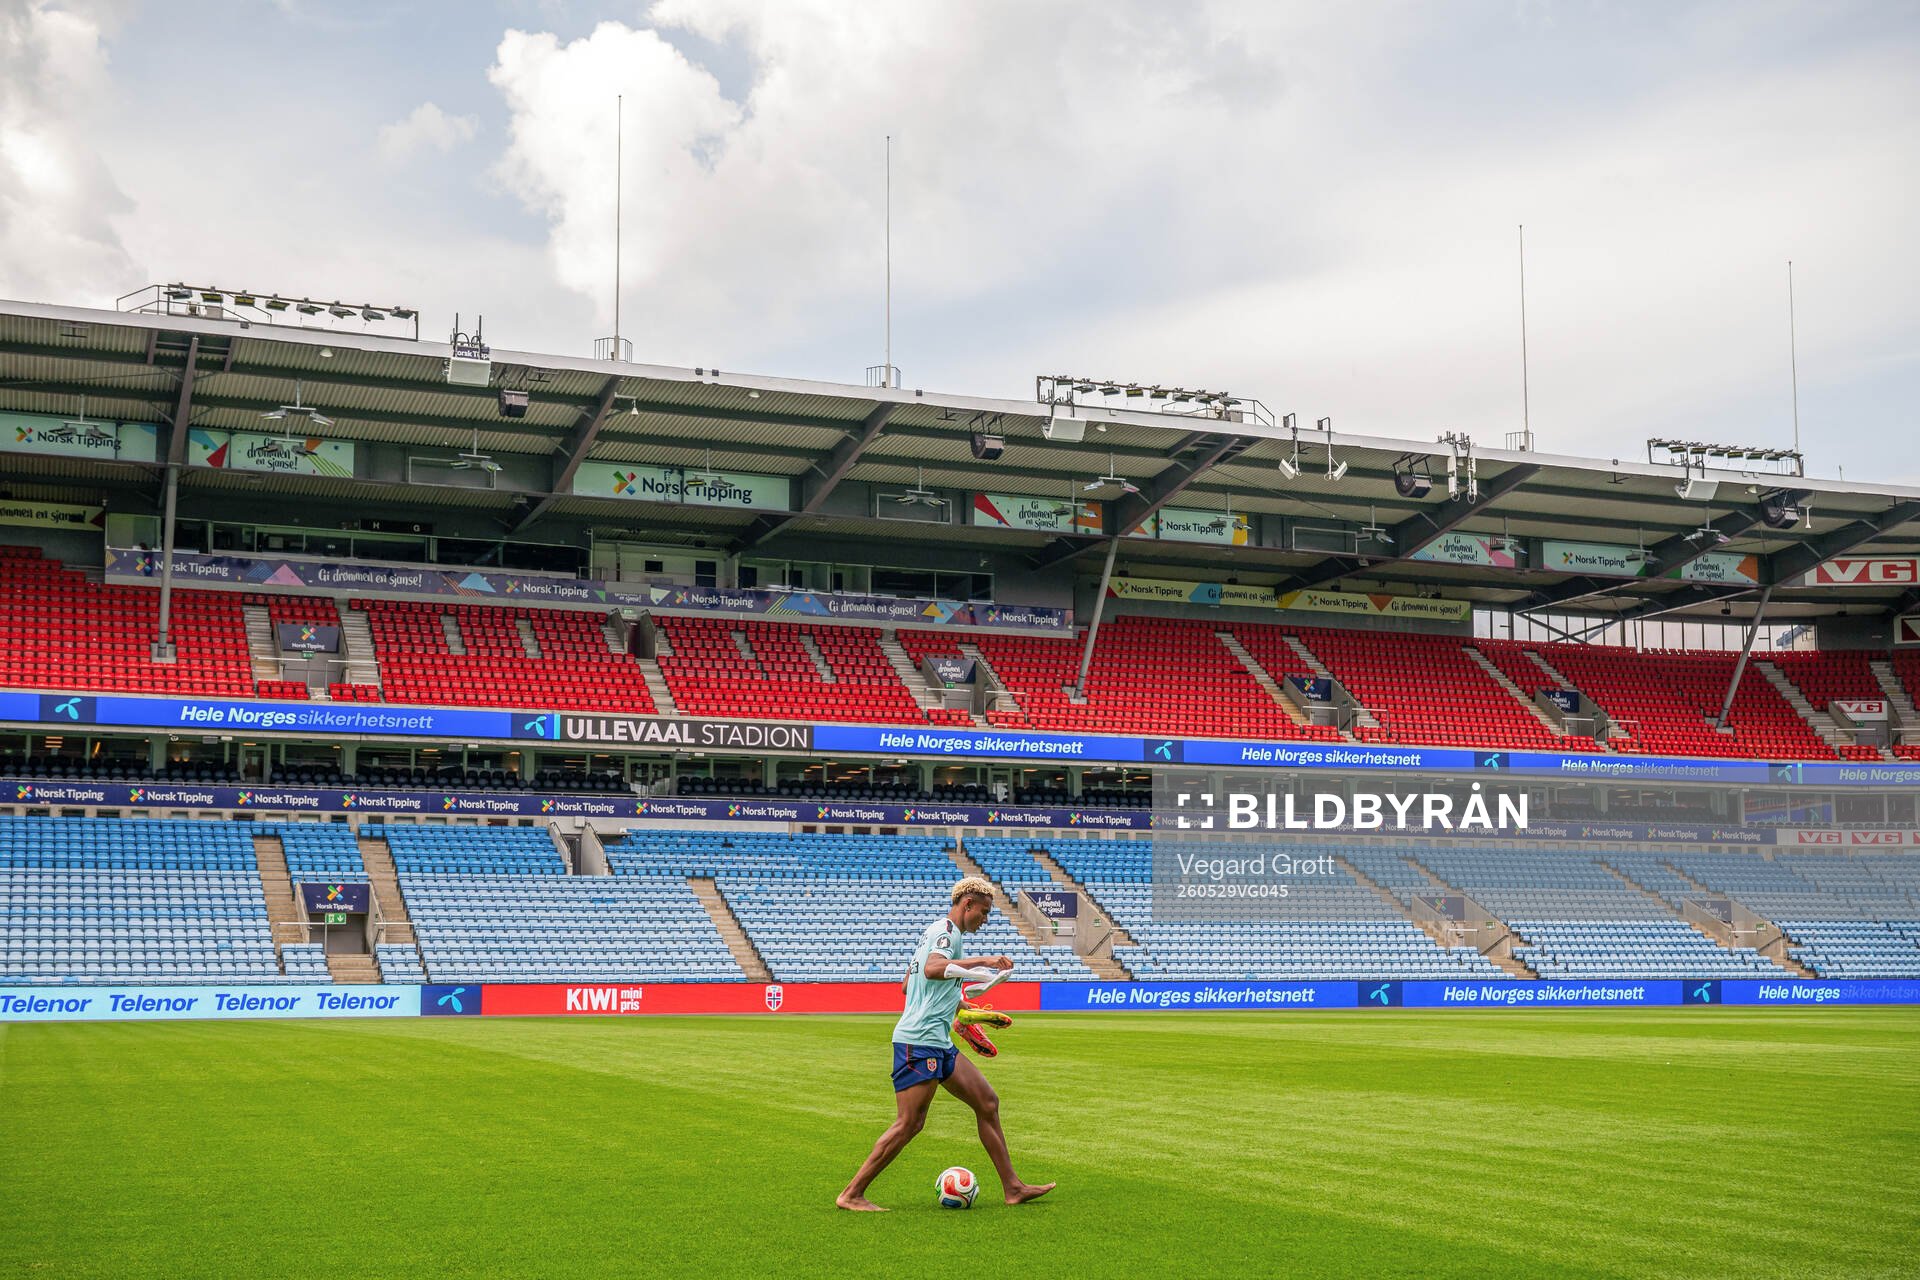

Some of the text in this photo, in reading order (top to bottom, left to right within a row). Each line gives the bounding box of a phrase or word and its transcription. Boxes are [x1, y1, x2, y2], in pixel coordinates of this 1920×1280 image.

[37, 430, 121, 450] Norsk Tipping
[642, 477, 689, 495] Norsk
[1166, 521, 1224, 536] Norsk Tipping
[1575, 555, 1625, 568] Norsk Tipping
[155, 560, 229, 577] Nrsk Tipping
[1821, 561, 1913, 582] VG
[523, 583, 589, 598] Norsk Tipping
[1131, 585, 1183, 597] Norsk Tipping
[692, 594, 753, 609] Norsk Tipping
[1320, 597, 1368, 610] Norsk Tipping
[1002, 612, 1058, 627] Norsk Tipping
[1840, 703, 1880, 713] VG
[181, 705, 434, 729] Hele Norges sikkerhetsnett
[567, 718, 808, 748] ULLEVAAL STADION
[879, 733, 1083, 754] Hele Norges sikkerhetsnett
[1241, 747, 1421, 767] Hele Norges sikkerhetsnett
[1561, 759, 1719, 777] Hele Norges sikkerhetsnett
[1839, 768, 1920, 783] Hele Norges
[35, 788, 104, 801] Norsk Tipping
[147, 792, 213, 804] Norsk Tipping
[255, 794, 318, 807] Norsk Tipping
[359, 797, 421, 810] Norsk Tipping
[459, 800, 519, 812] Norsk Tipping
[557, 802, 614, 814] Norsk Tipping
[650, 804, 707, 817] Norsk Tipping
[742, 807, 797, 819] Norsk Tipping
[831, 809, 885, 821] Norsk Tipping
[917, 811, 969, 822] Norsk Tipping
[1001, 813, 1051, 824] Norsk Tipping
[1083, 815, 1131, 826] Norsk Tipping
[1526, 827, 1567, 837] Norsk Tipping
[1592, 828, 1632, 839] Norsk Tipping
[1658, 830, 1698, 840] Norsk Tipping
[1721, 831, 1761, 842] Norsk Tipping
[1799, 832, 1841, 843] VG
[1853, 832, 1901, 844] VG
[333, 903, 354, 911] Tipping
[566, 987, 643, 1011] KIWI mini
[1087, 987, 1316, 1007] Hele Norges sikkerhetsnett
[1443, 985, 1645, 1004] Hele Norges sikkerhetsnett
[1758, 985, 1789, 999] Hele
[1791, 986, 1841, 1002] Norges
[0, 995, 92, 1013] Telenor
[109, 994, 199, 1012] Telenor
[215, 993, 301, 1011] Telenor
[316, 992, 400, 1010] Telenor
[620, 999, 640, 1013] pris
